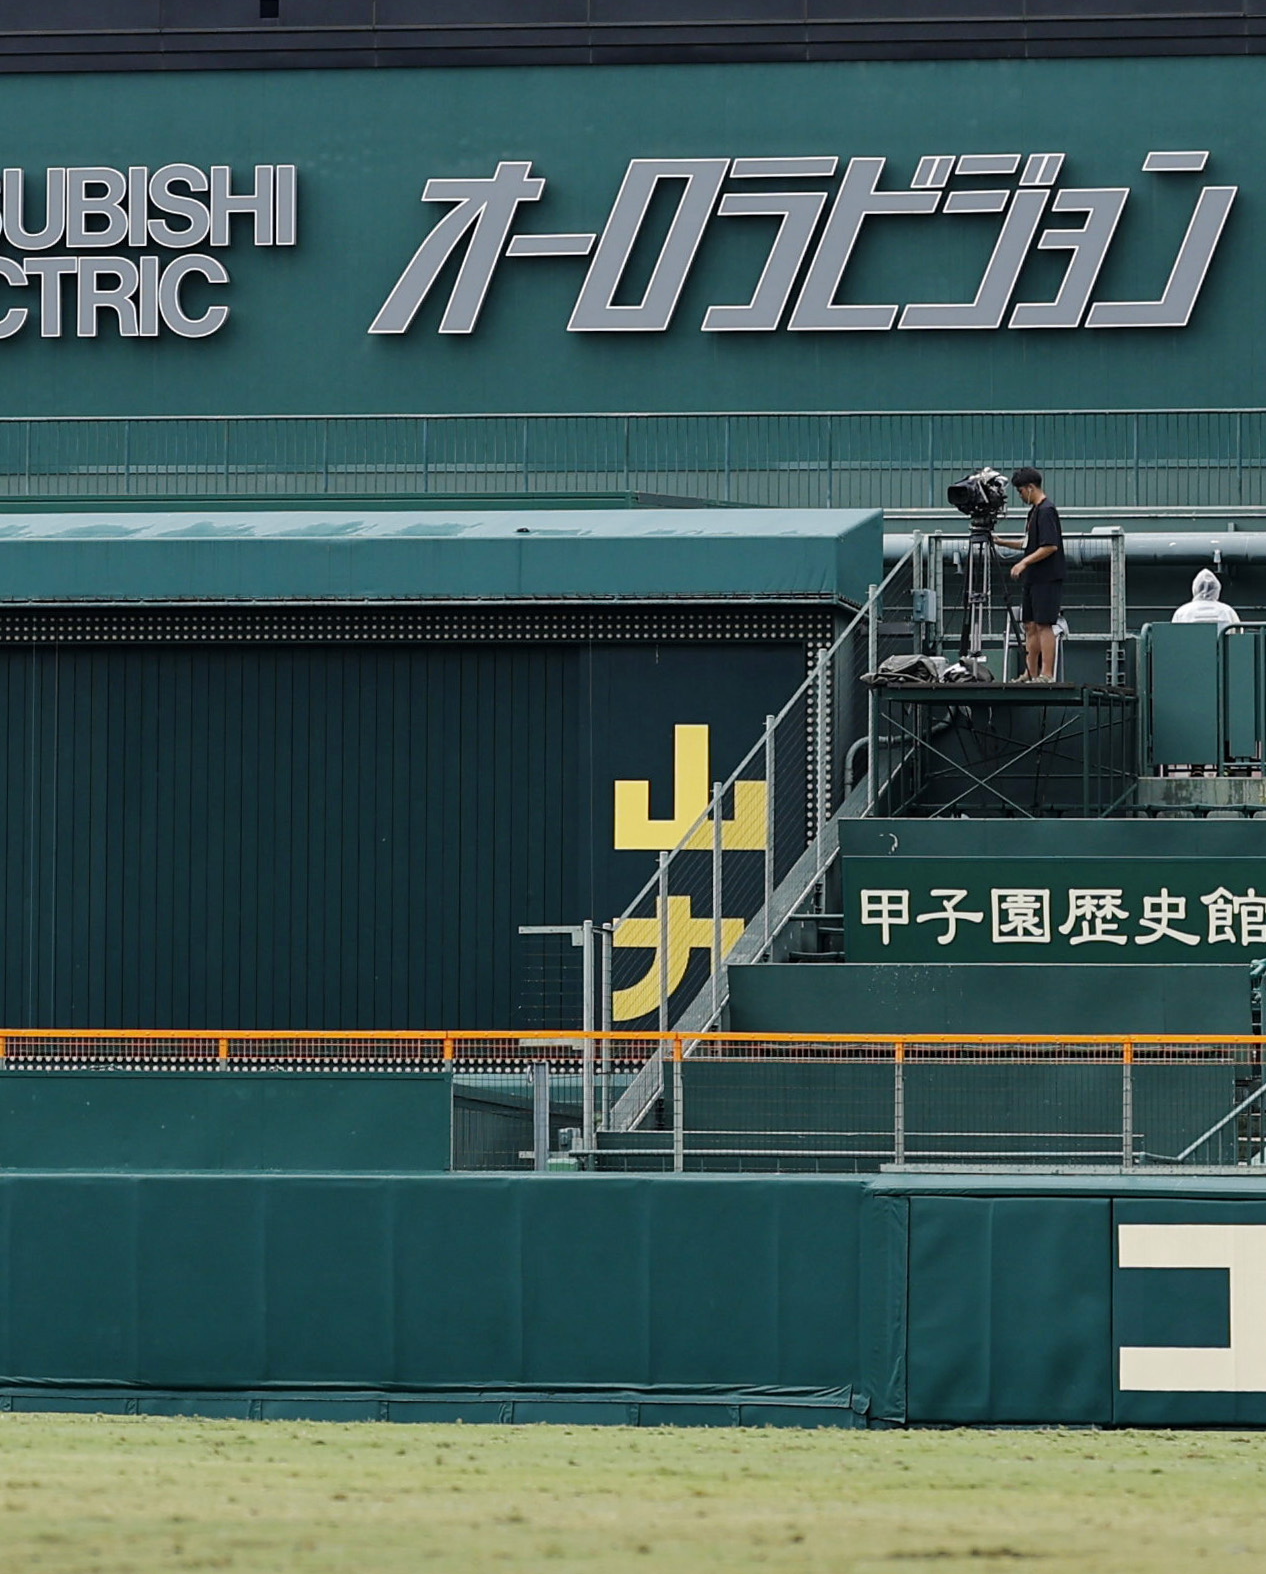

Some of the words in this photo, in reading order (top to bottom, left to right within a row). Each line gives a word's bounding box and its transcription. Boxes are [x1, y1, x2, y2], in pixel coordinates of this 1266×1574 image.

[0, 162, 297, 251] UBISHI
[367, 151, 1238, 334] オーロラビジョン
